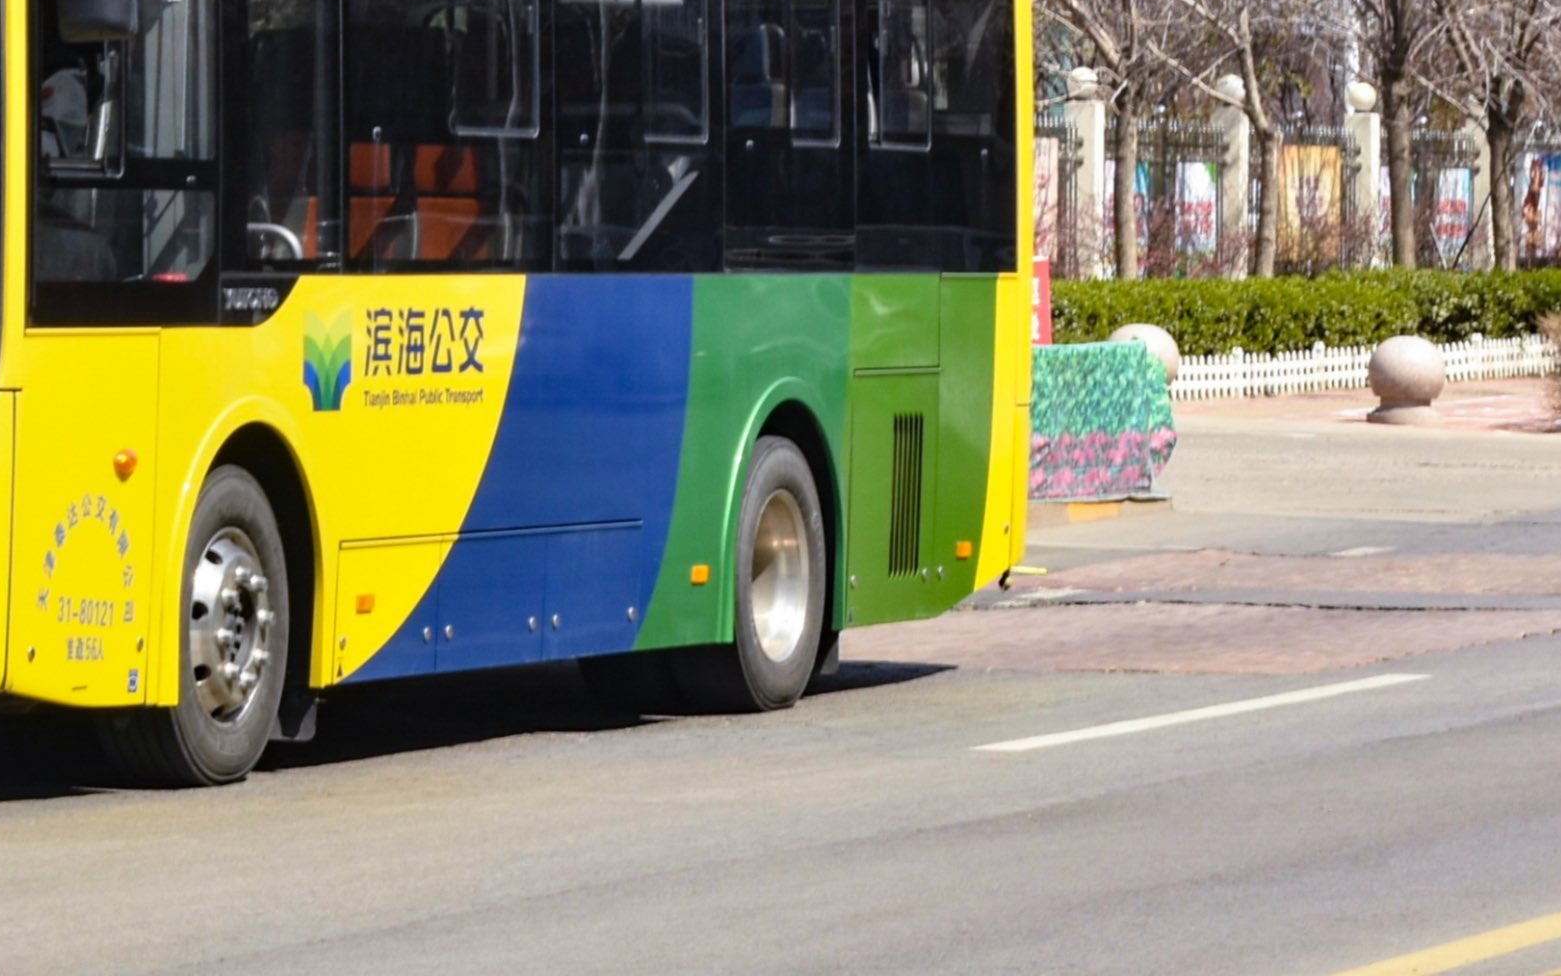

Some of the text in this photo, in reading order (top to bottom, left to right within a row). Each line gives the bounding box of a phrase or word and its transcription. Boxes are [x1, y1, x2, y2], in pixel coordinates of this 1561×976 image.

[364, 306, 485, 377] 滨海公交
[363, 387, 484, 410] Tianjin Binhai Public Transport
[56, 596, 116, 627] 31-80121
